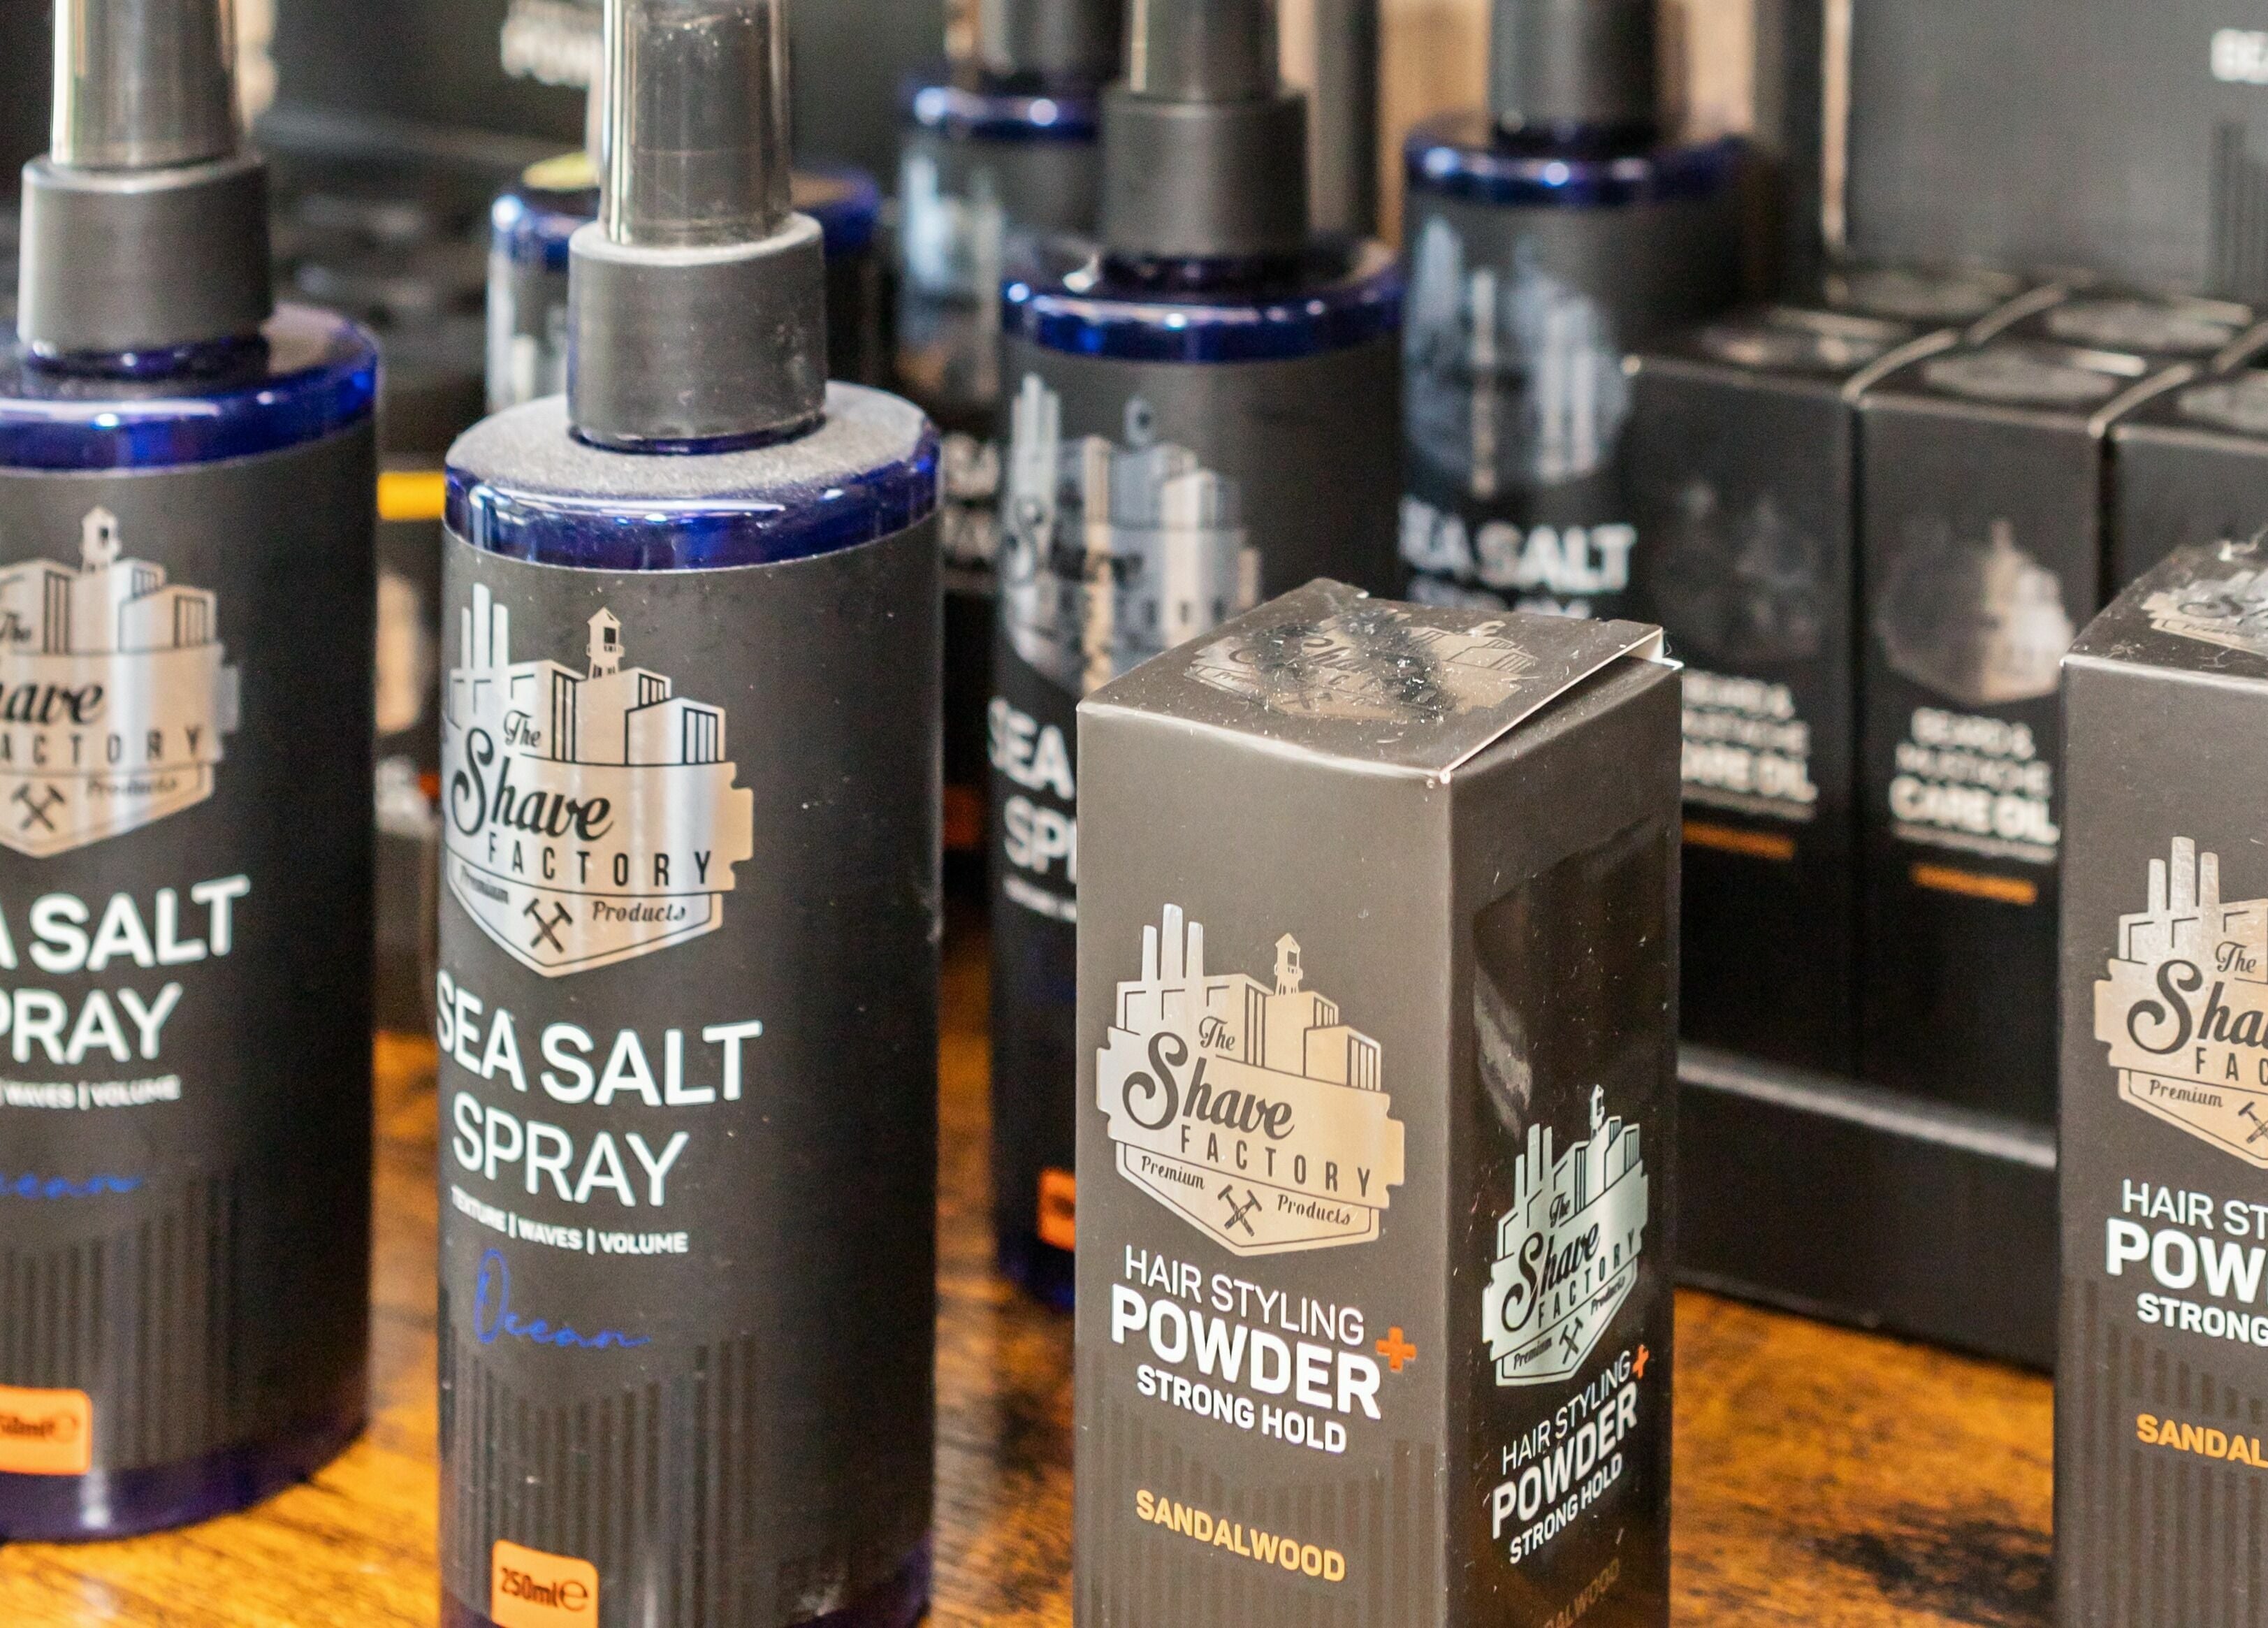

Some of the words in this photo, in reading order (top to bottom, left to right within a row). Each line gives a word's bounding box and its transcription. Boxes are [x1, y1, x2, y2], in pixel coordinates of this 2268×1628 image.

[1476, 520, 1638, 594] SALT
[0, 681, 103, 725] ave
[504, 710, 541, 748] The
[451, 727, 614, 841] Shave
[489, 831, 711, 887] FACTORY
[1004, 794, 1077, 885] SP
[29, 873, 252, 973] SALT
[592, 900, 686, 923] Products
[2215, 940, 2257, 974] The
[437, 969, 528, 1092] SEA
[540, 1019, 763, 1107] SALT
[1199, 1016, 1235, 1051] The
[1122, 1031, 1295, 1140] Shave
[2149, 1079, 2224, 1108] Premium
[452, 1091, 690, 1207] SPRAY
[1181, 1124, 1371, 1198] FACTORY
[1141, 1155, 1205, 1191] Premium
[1277, 1193, 1351, 1226] Products
[1549, 1192, 1571, 1228] The
[2122, 1178, 2214, 1230] HAIR
[518, 1218, 583, 1250] WAVES
[598, 1232, 689, 1256] VOLUME
[1502, 1222, 1601, 1332] Shave
[1539, 1228, 1635, 1328] FACTORY
[473, 1248, 653, 1349] Ocean
[1126, 1244, 1202, 1303] HAIR
[1211, 1274, 1365, 1346] STYLING
[2136, 1292, 2268, 1347] STRONG
[1137, 1364, 1256, 1430] STRONG
[1262, 1404, 1347, 1454] HOLD
[1502, 1419, 1550, 1475] HAIR
[1555, 1350, 1631, 1439] STYLING
[1136, 1488, 1346, 1583] SANDALWOOD
[1509, 1493, 1578, 1564] STRONG
[1581, 1453, 1622, 1510] HOLD
